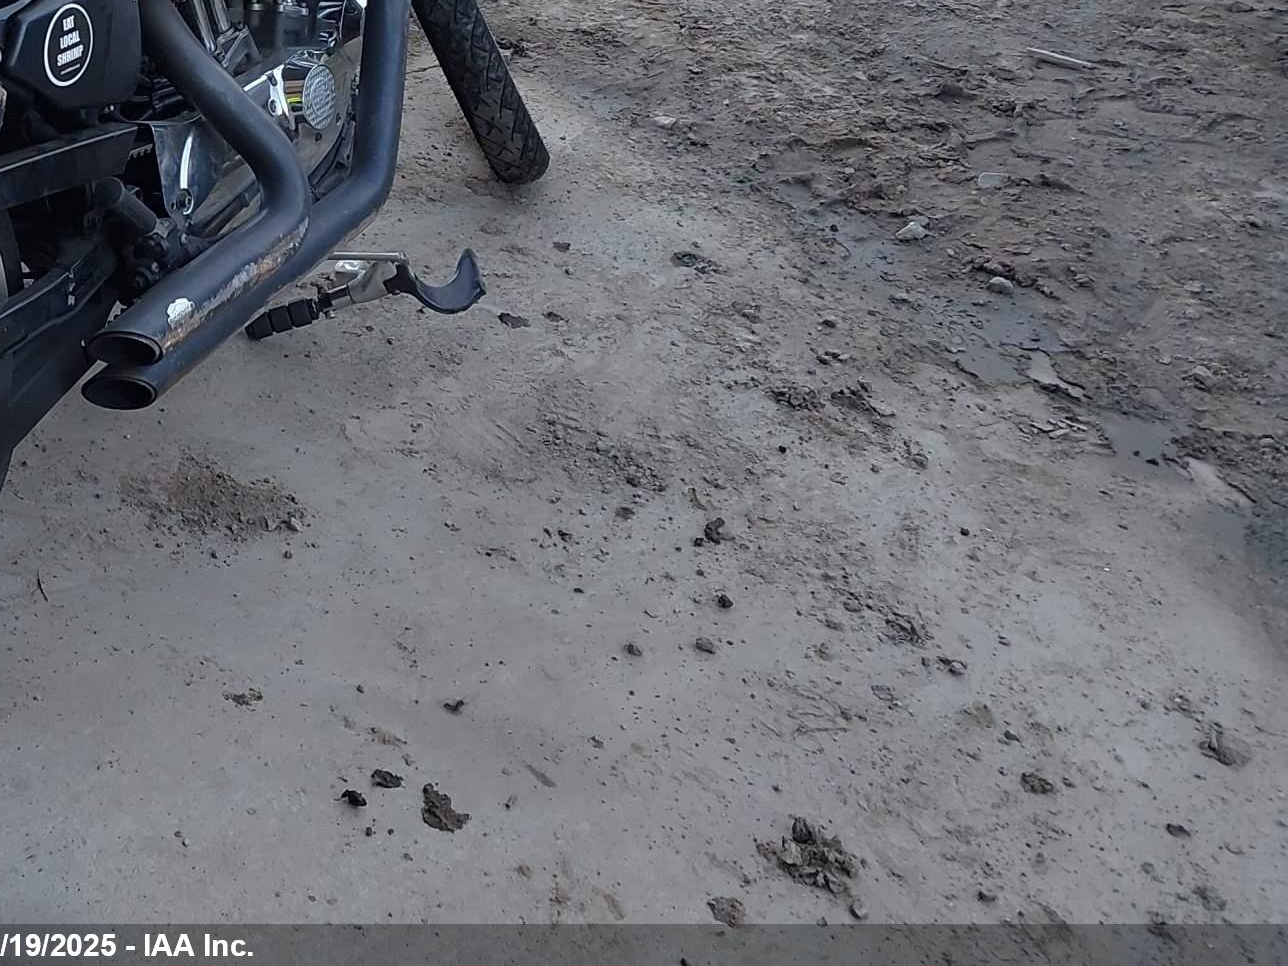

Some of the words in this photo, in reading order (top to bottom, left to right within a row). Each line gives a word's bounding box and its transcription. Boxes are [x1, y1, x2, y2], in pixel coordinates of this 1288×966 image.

[62, 15, 75, 32] EAT
[59, 30, 81, 50] LOCAL
[57, 44, 84, 67] SHRIMP
